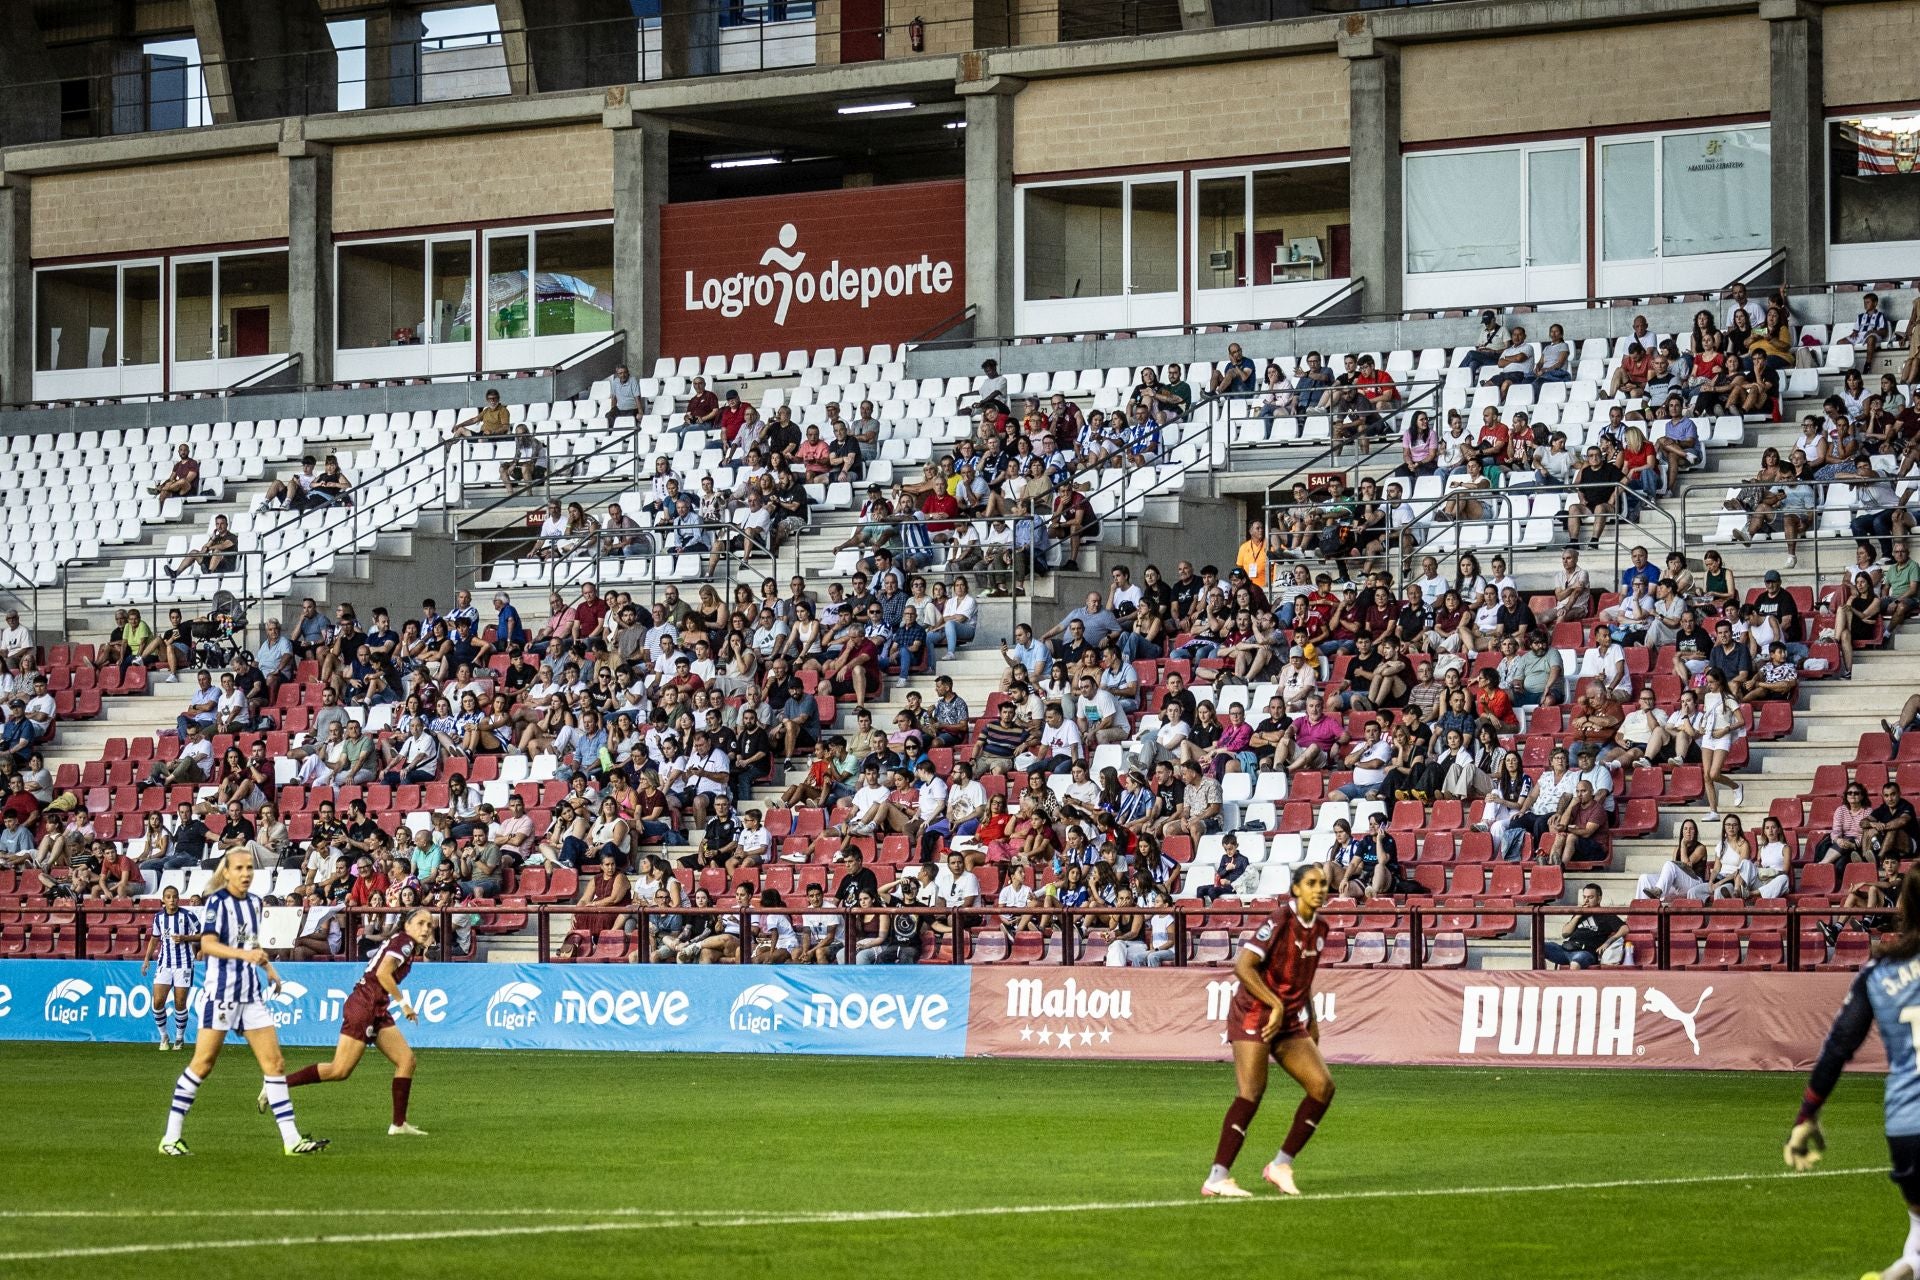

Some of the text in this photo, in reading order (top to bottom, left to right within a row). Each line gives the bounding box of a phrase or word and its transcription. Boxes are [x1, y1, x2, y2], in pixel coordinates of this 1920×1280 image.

[820, 254, 953, 308] deporte
[52, 1005, 88, 1024] Liga F
[554, 989, 690, 1026] moeve
[802, 992, 949, 1031] moeve
[1005, 977, 1133, 1019] Mahou
[293, 1009, 302, 1025] F
[494, 1010, 537, 1030] Liga F
[738, 1013, 783, 1034] Liga F
[1458, 986, 1637, 1056] PUMA
